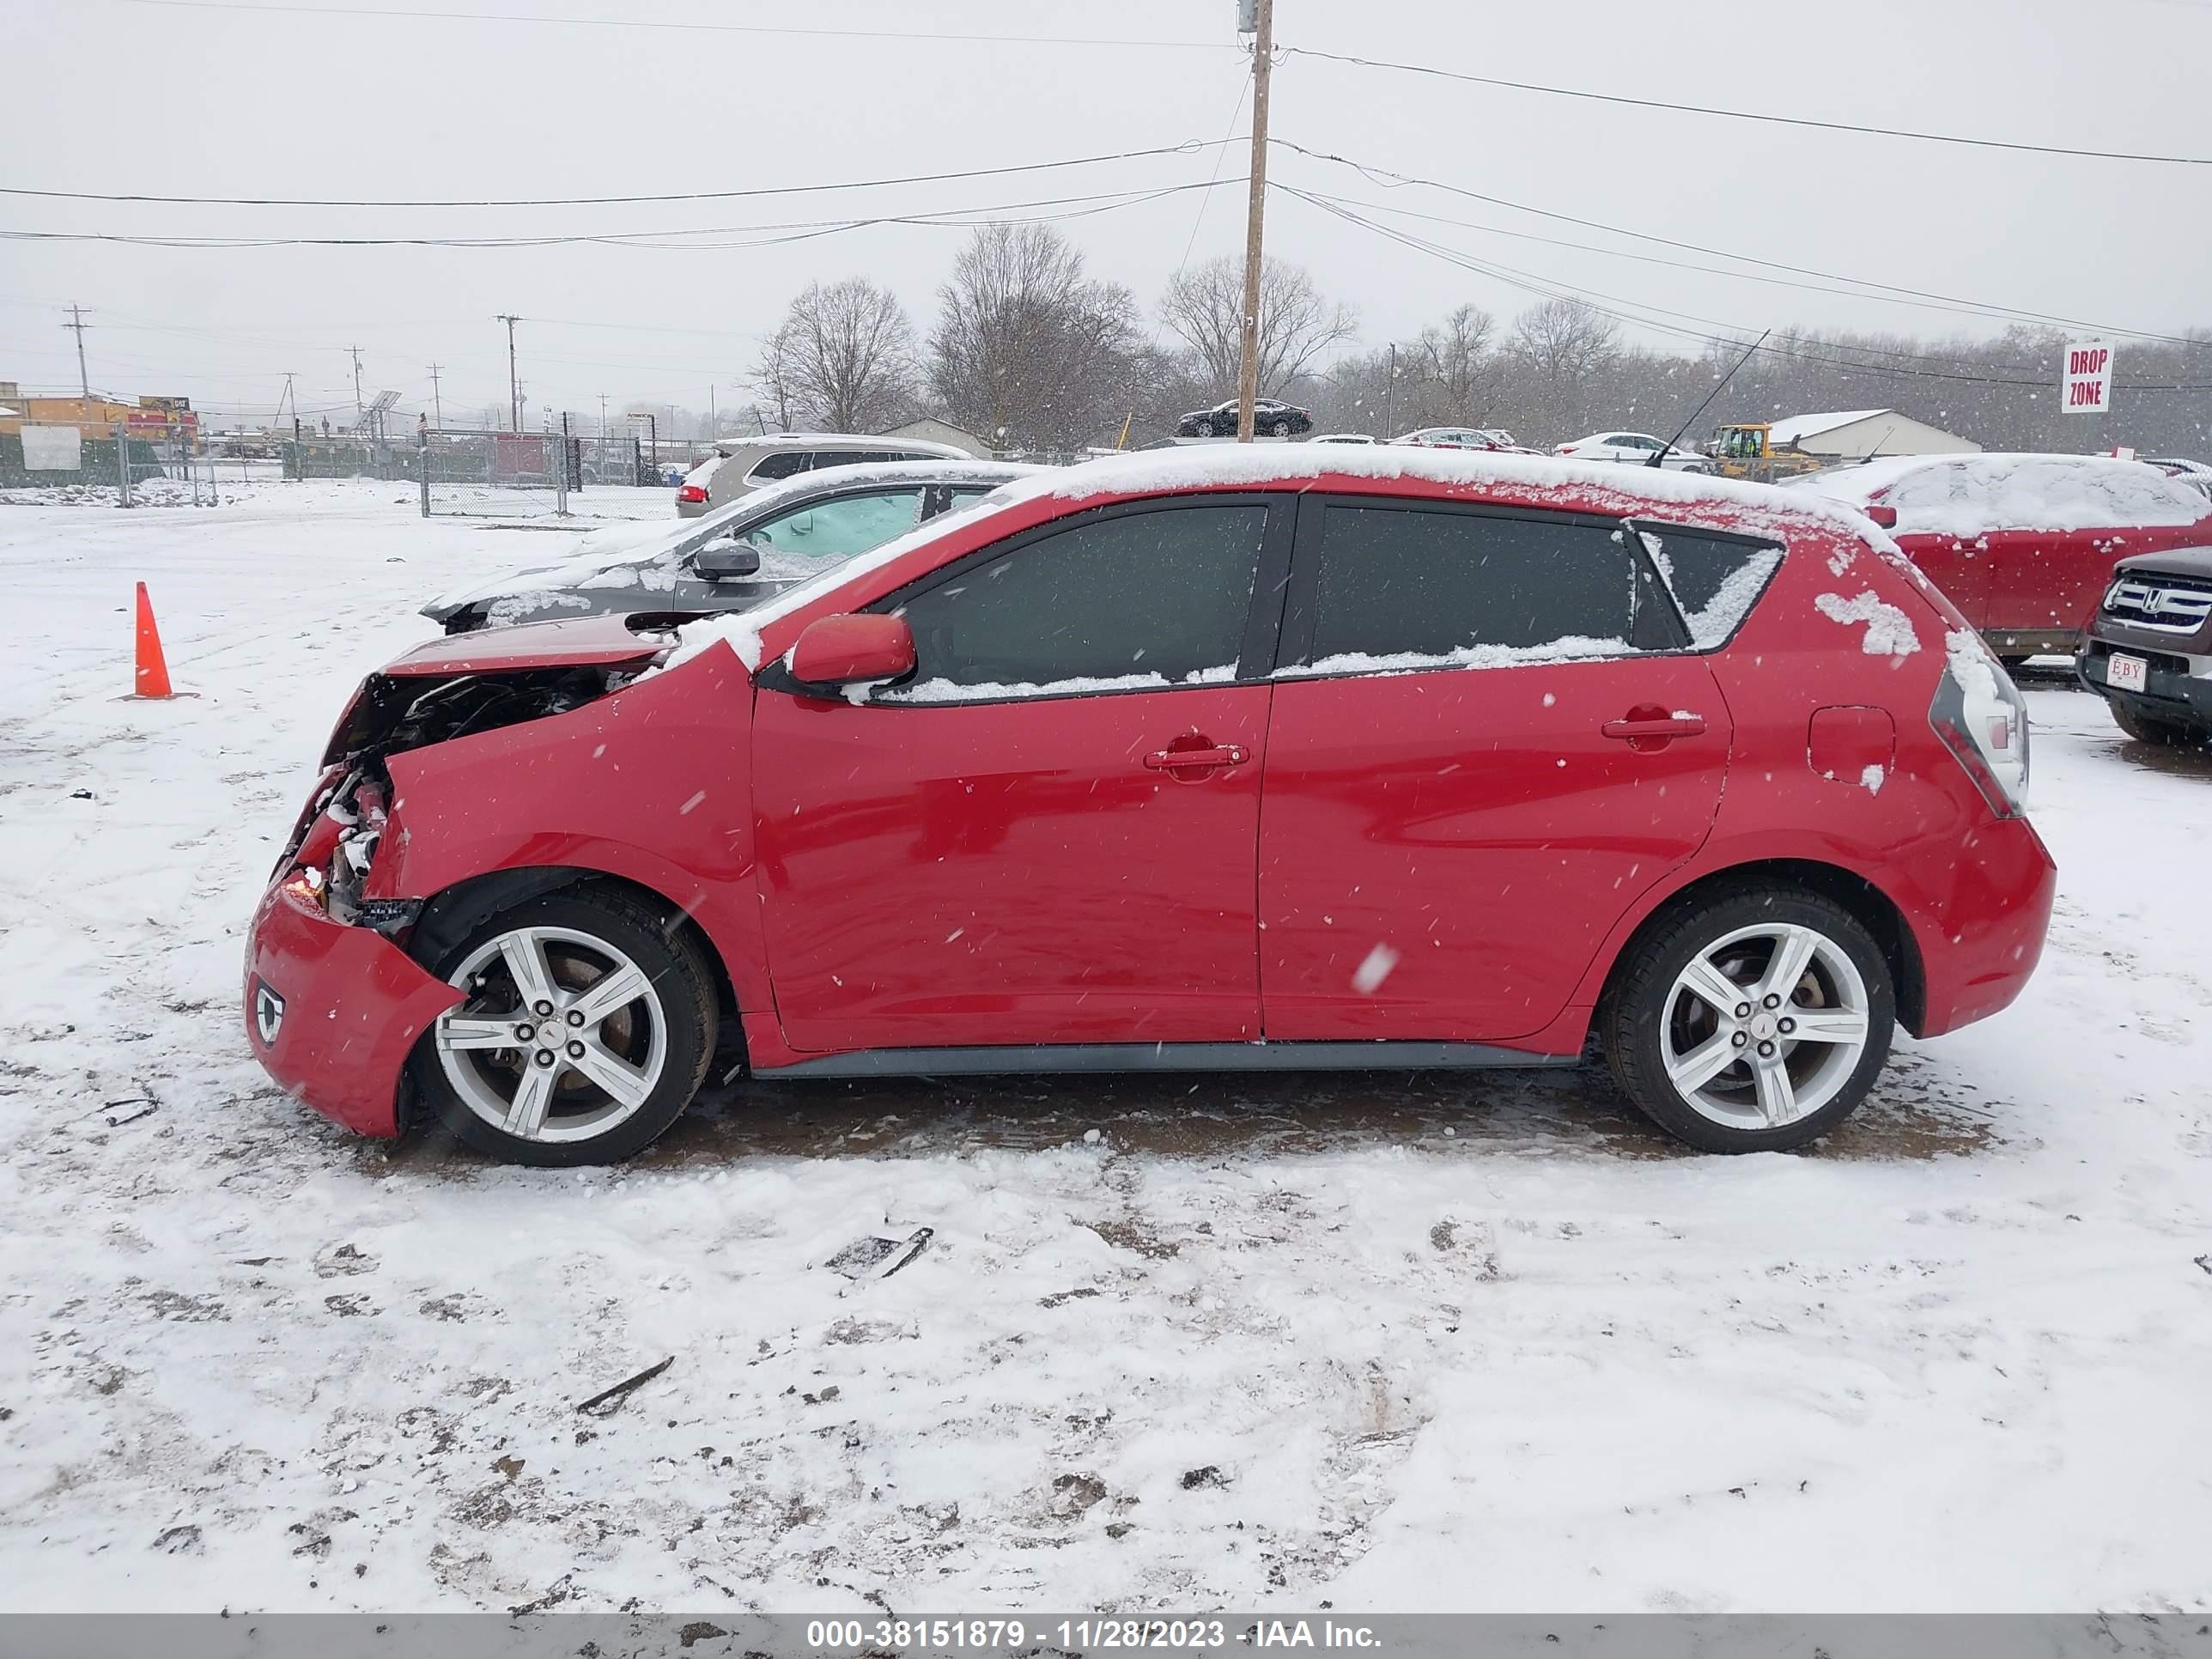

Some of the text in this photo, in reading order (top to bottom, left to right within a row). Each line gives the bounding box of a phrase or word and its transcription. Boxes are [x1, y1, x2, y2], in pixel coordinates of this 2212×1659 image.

[2070, 349, 2108, 374] DROP
[174, 399, 186, 408] CAT
[2069, 381, 2102, 406] ZONE
[2112, 659, 2142, 678] EBY
